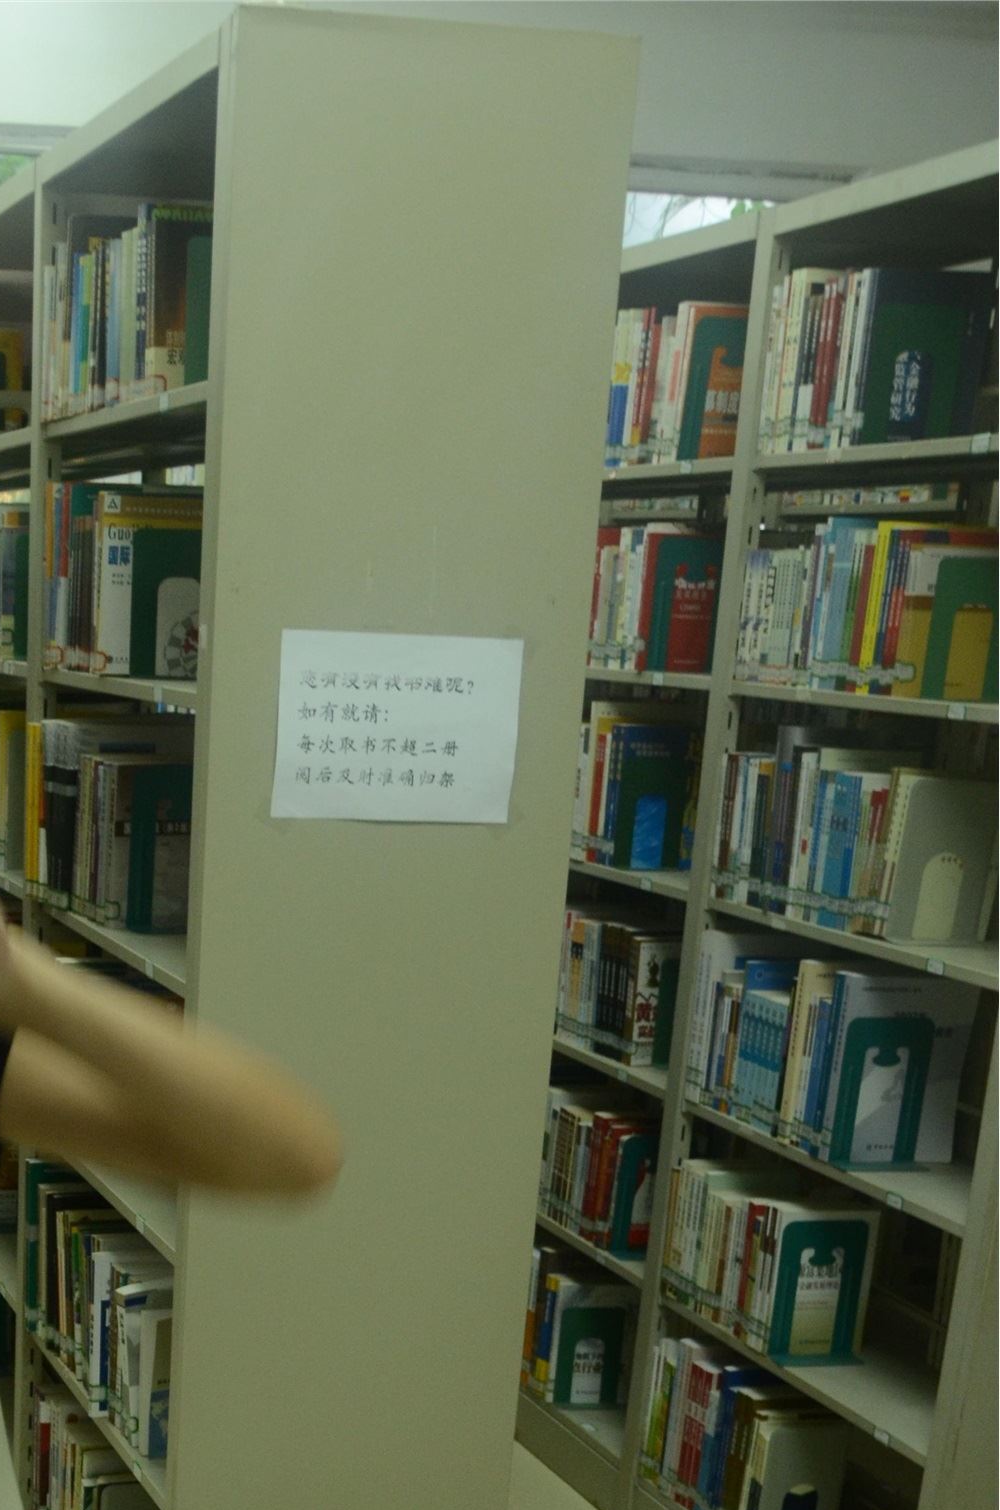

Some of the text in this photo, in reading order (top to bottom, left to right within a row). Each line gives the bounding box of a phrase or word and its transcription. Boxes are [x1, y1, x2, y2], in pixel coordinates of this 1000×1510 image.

[296, 733, 459, 757] 每次取书不超二册
[295, 765, 456, 788] 阅后及时准确归架
